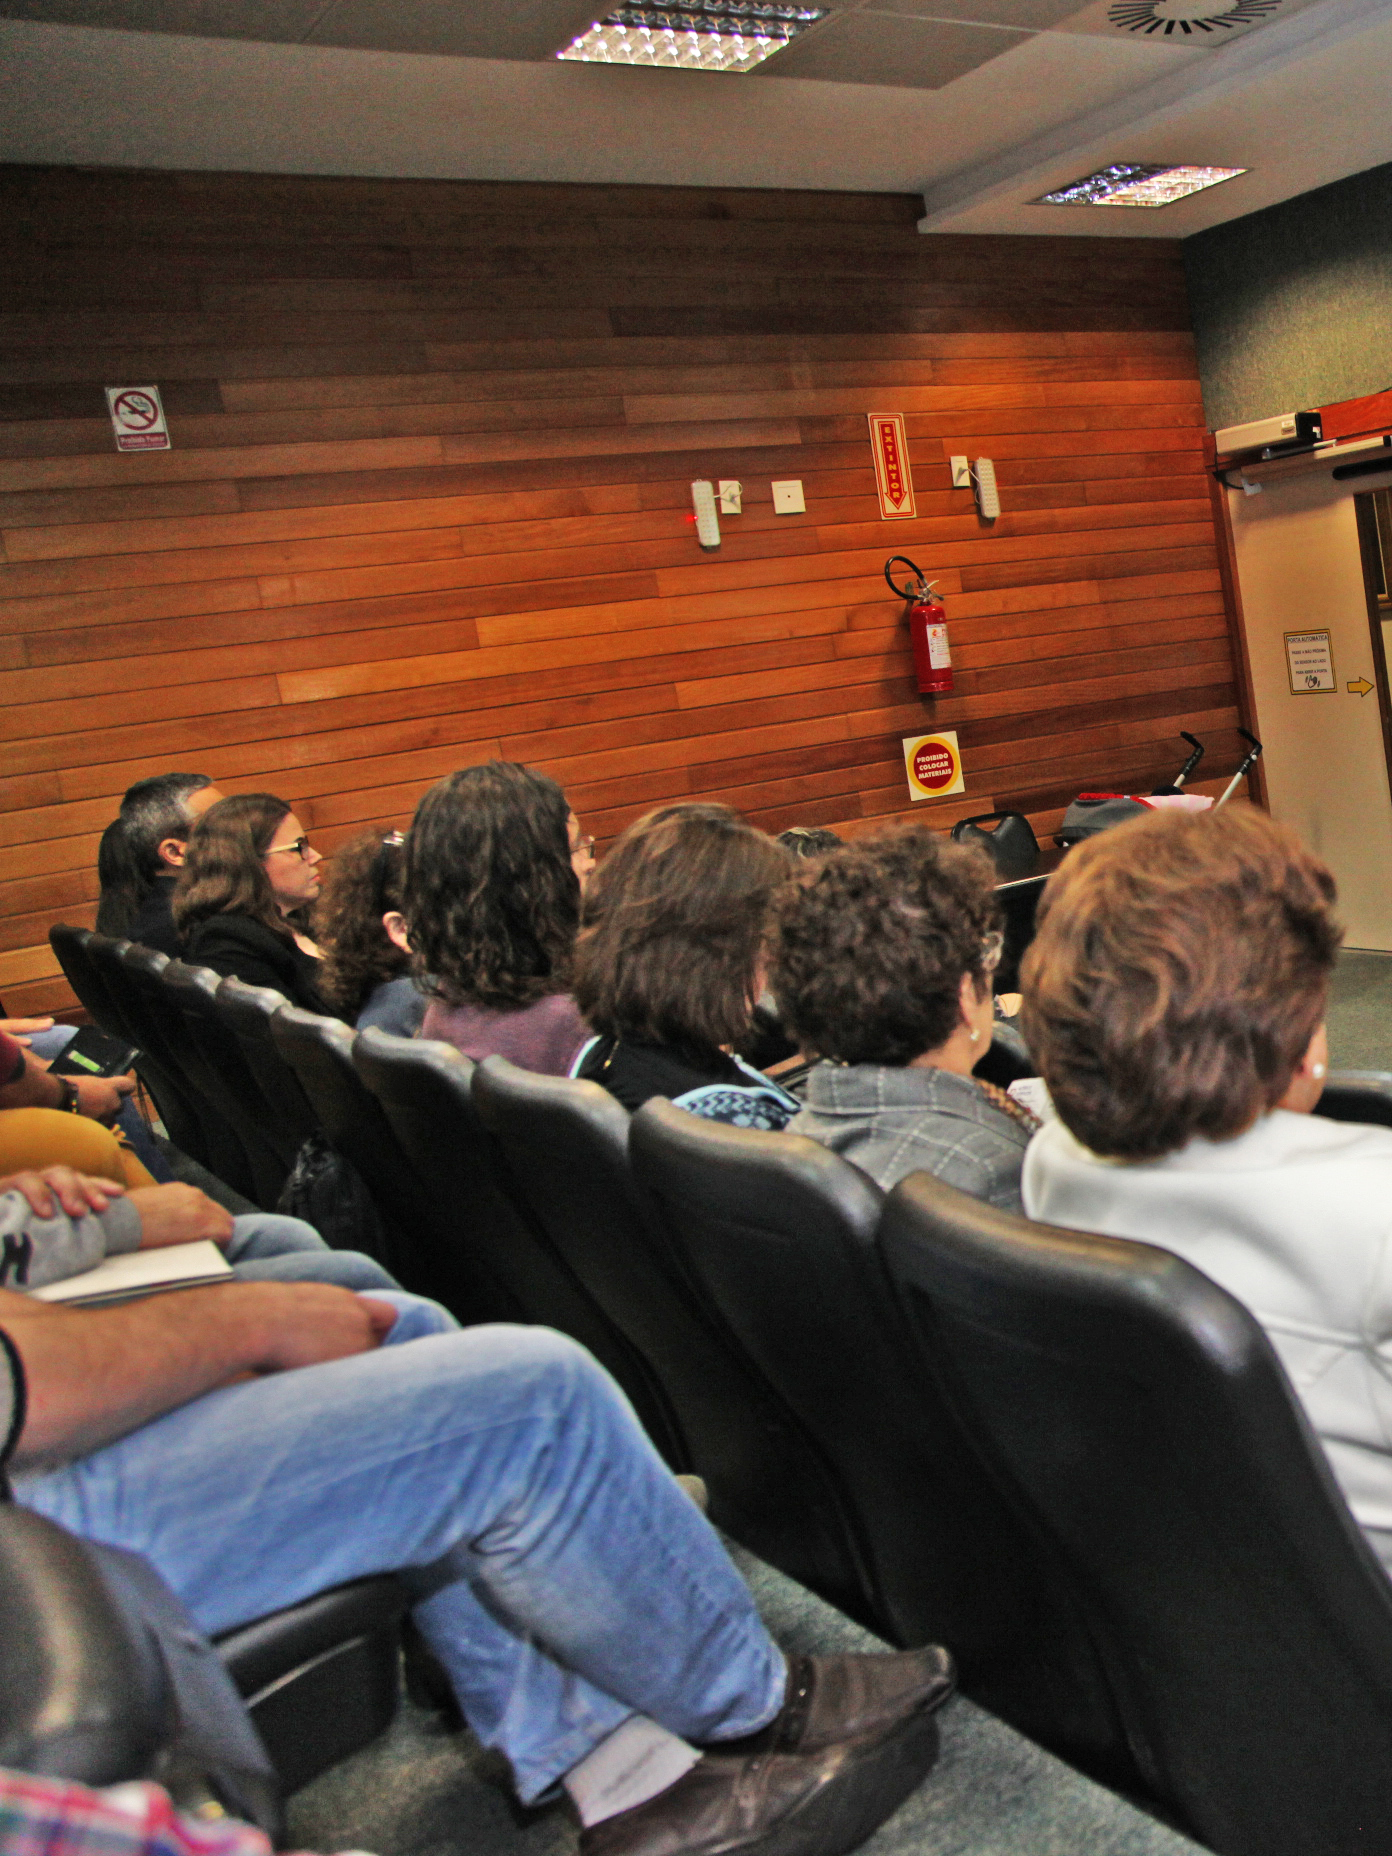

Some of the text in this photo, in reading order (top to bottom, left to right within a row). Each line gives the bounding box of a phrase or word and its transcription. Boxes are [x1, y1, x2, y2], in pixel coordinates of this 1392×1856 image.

[884, 426, 900, 499] EXTINTOR
[916, 752, 949, 764] PROIBIDO
[919, 760, 949, 771] COLOCAR
[918, 768, 953, 780] MATERIAIS
